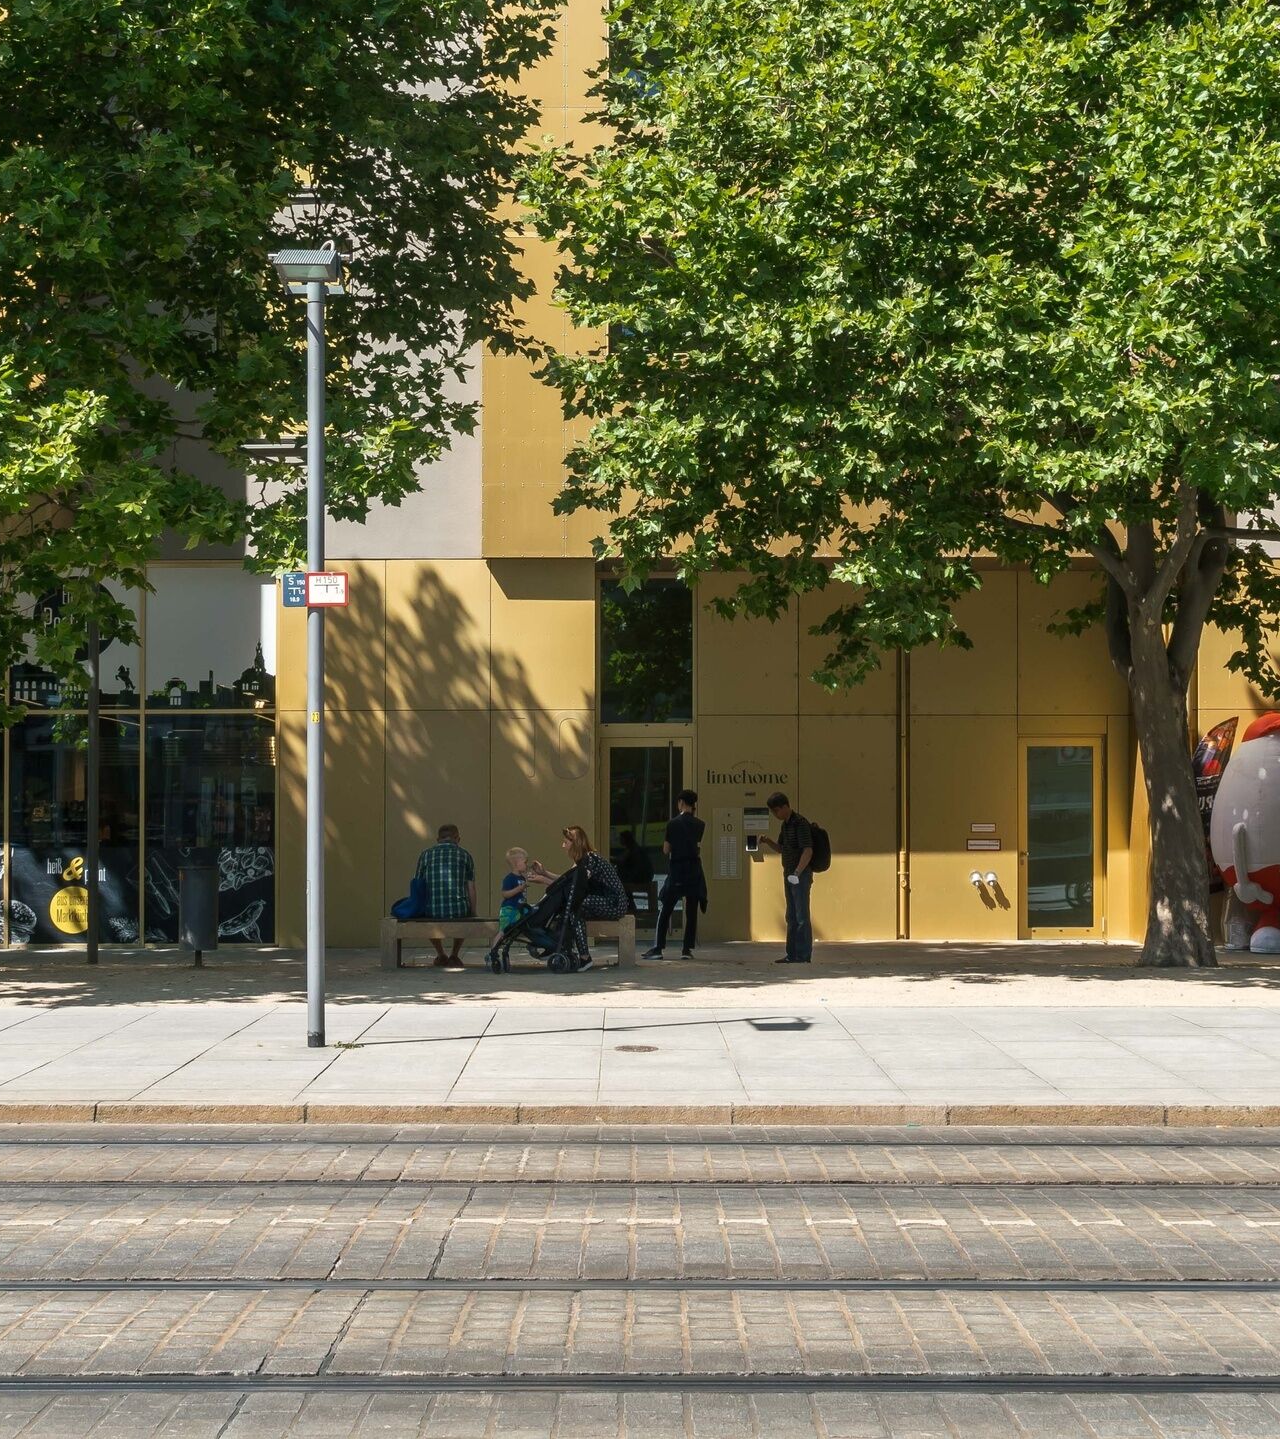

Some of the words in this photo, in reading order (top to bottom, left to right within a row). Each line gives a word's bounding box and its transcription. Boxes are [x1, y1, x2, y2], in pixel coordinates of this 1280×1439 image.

[288, 577, 295, 586] S
[706, 769, 789, 785] limehome
[721, 823, 733, 833] 10
[46, 858, 63, 875] heiß
[62, 856, 84, 881] &
